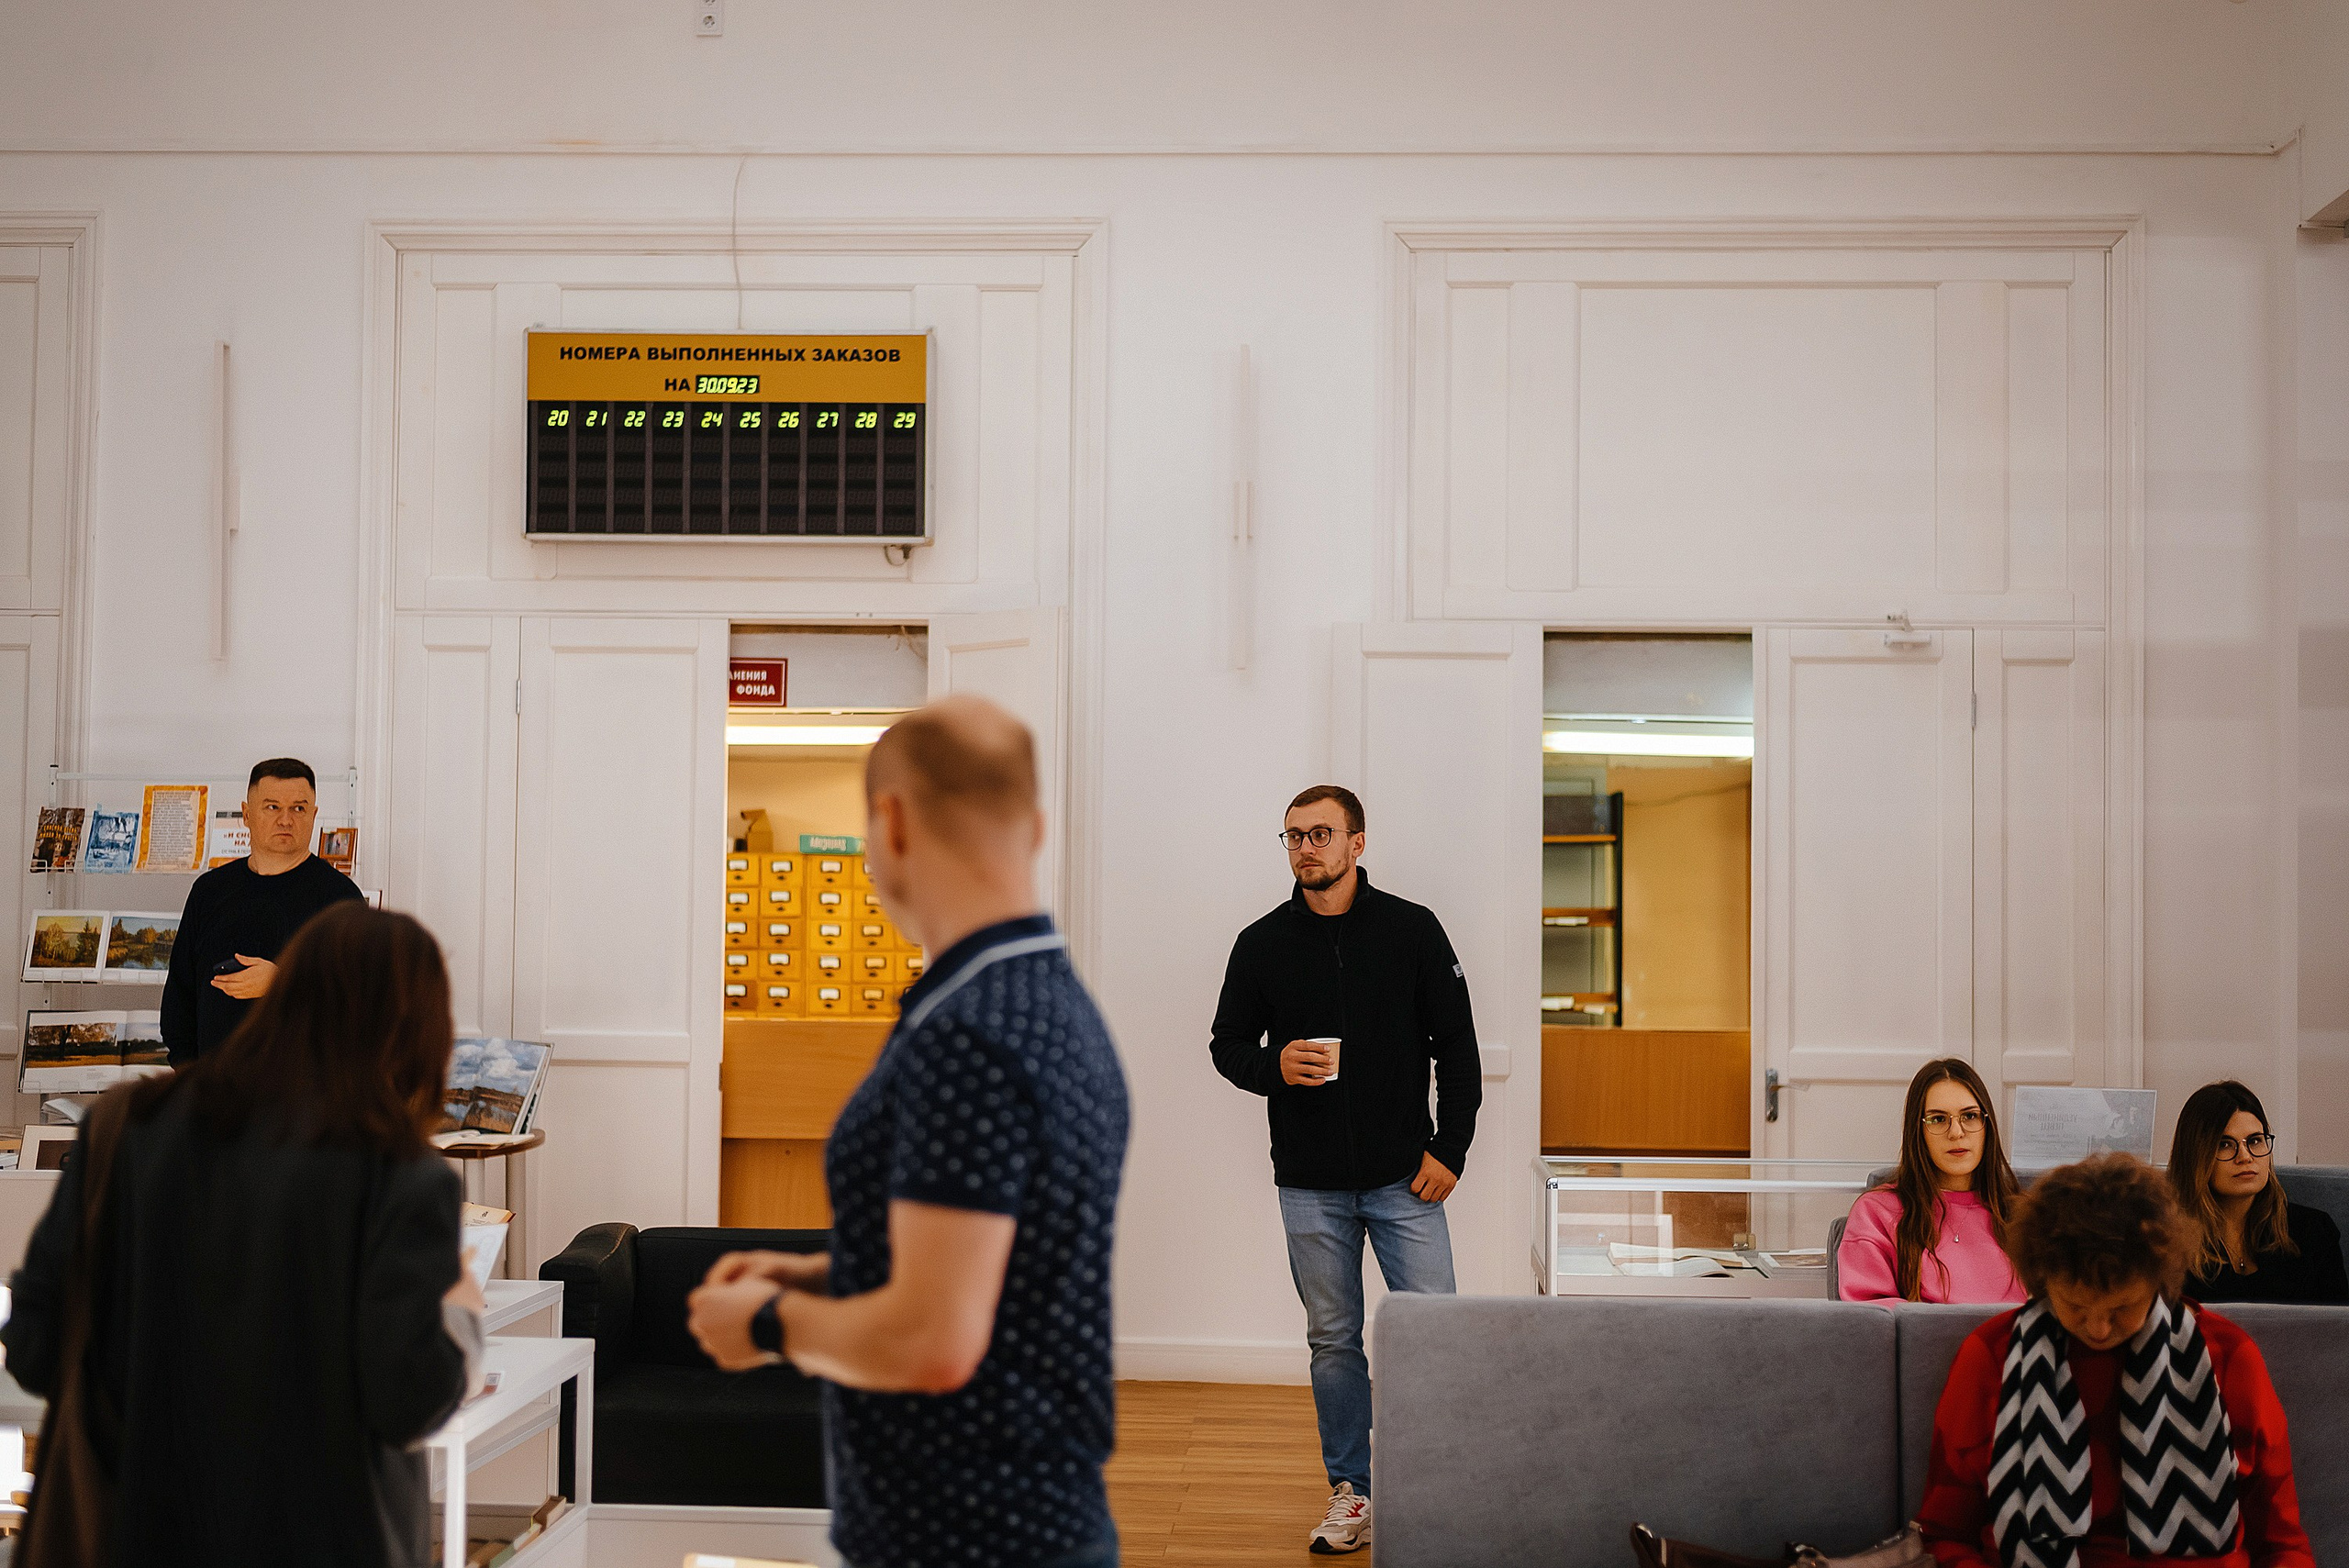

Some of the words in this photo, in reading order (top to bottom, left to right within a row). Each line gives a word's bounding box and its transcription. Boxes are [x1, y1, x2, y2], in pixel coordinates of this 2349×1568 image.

[559, 346, 640, 361] НОМЕРА
[647, 347, 806, 361] ВЫПОЛНЕННЫХ
[812, 348, 901, 362] ЗАКАЗОВ
[664, 378, 691, 392] НА
[547, 409, 569, 427] 20
[585, 410, 607, 428] 21
[624, 410, 646, 428] 22
[662, 410, 685, 428] 23
[700, 411, 723, 428] 24
[739, 411, 762, 428] 25
[777, 411, 800, 428] 26
[816, 411, 839, 428] 27
[854, 411, 877, 428] 28
[893, 411, 917, 428] 29
[736, 684, 776, 697] ФОНДА
